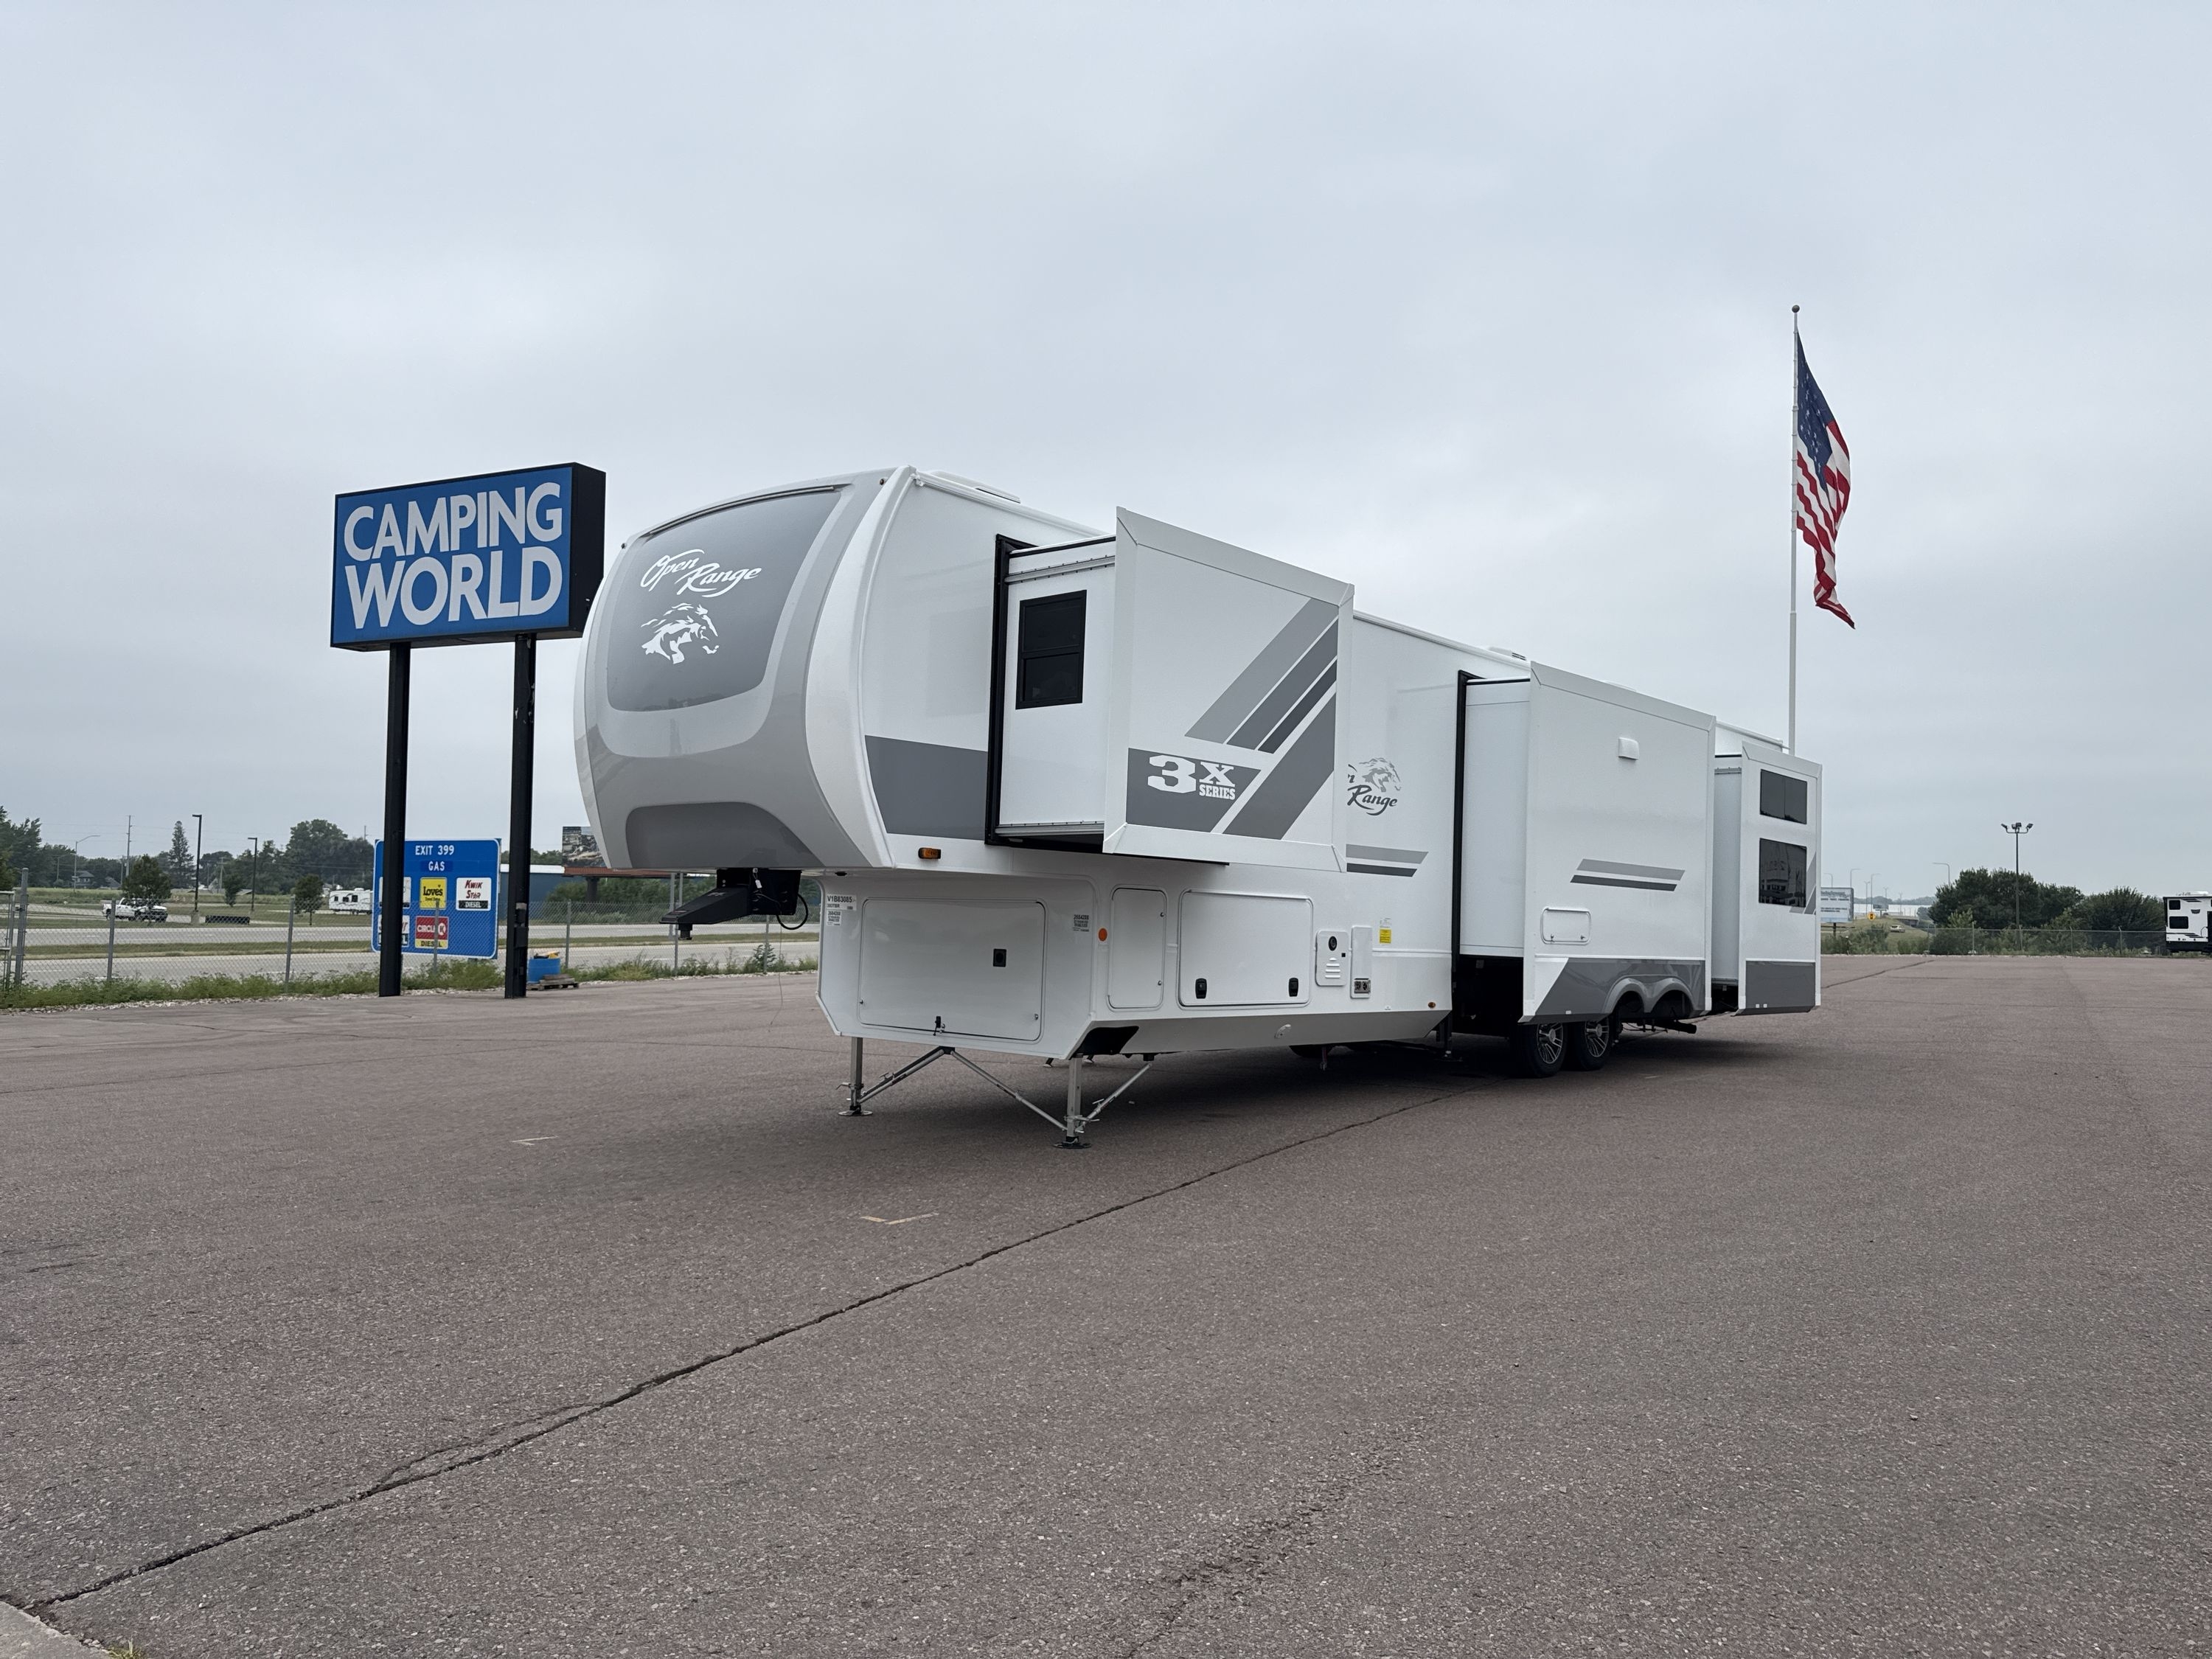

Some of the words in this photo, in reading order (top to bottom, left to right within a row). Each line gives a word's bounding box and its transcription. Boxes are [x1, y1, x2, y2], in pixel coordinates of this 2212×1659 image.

[344, 482, 563, 562] CAMPING
[640, 549, 705, 592] Open
[674, 563, 762, 598] Range
[345, 546, 563, 629] WORLD
[1199, 784, 1236, 800] SERIES
[1347, 785, 1398, 816] Range
[415, 845, 434, 855] EXIT
[437, 845, 455, 855] 399
[428, 860, 445, 872] GAS
